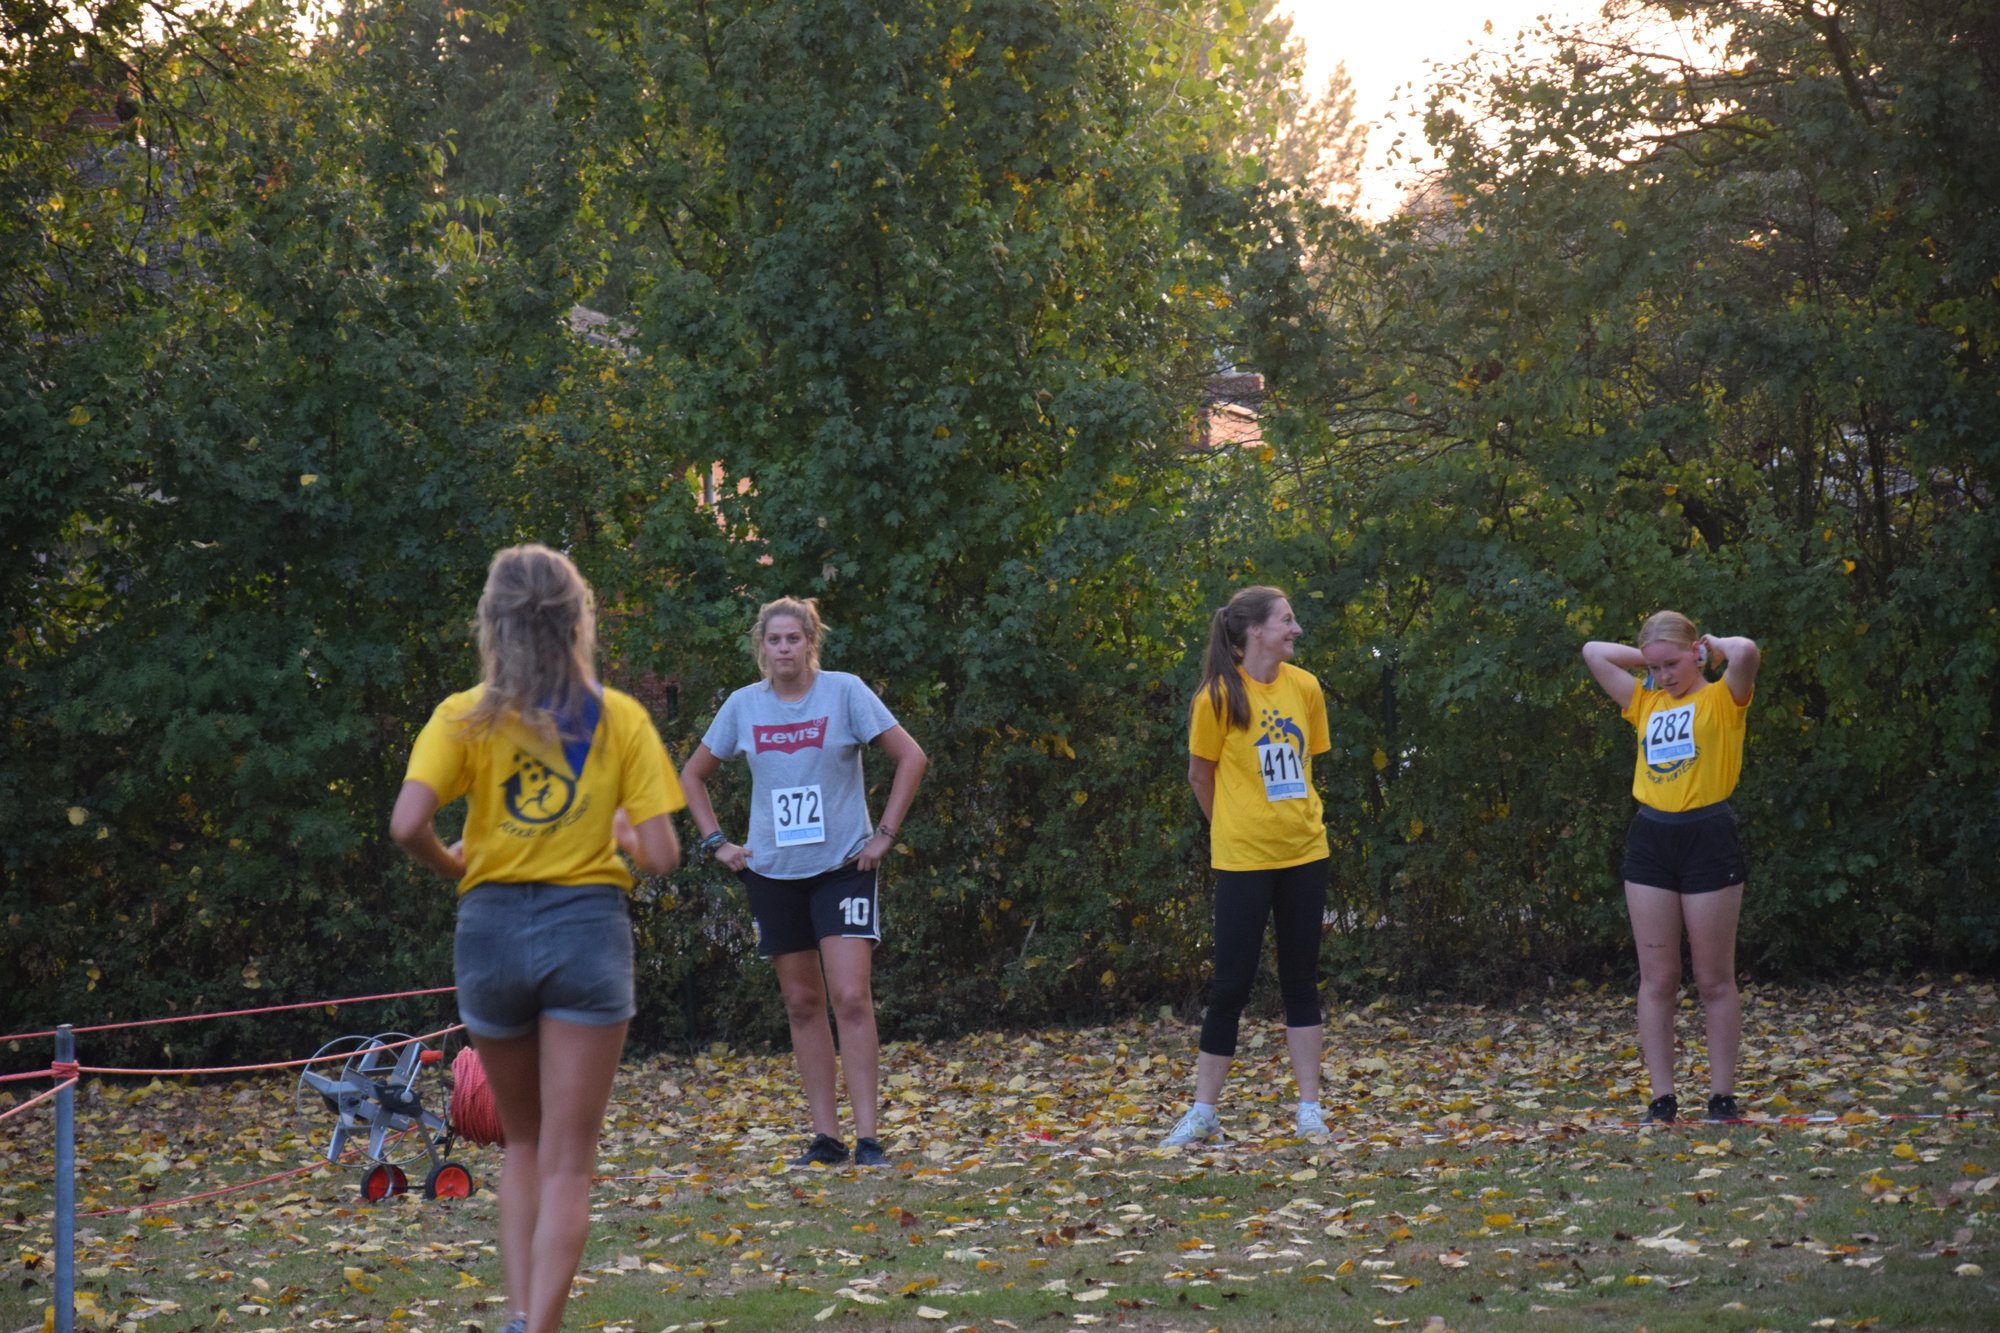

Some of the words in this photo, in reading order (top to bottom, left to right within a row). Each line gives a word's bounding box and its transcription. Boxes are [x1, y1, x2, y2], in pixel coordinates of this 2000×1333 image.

[1651, 710, 1691, 745] 282
[1264, 748, 1299, 782] 411
[777, 790, 820, 827] 372
[839, 897, 870, 926] 10
